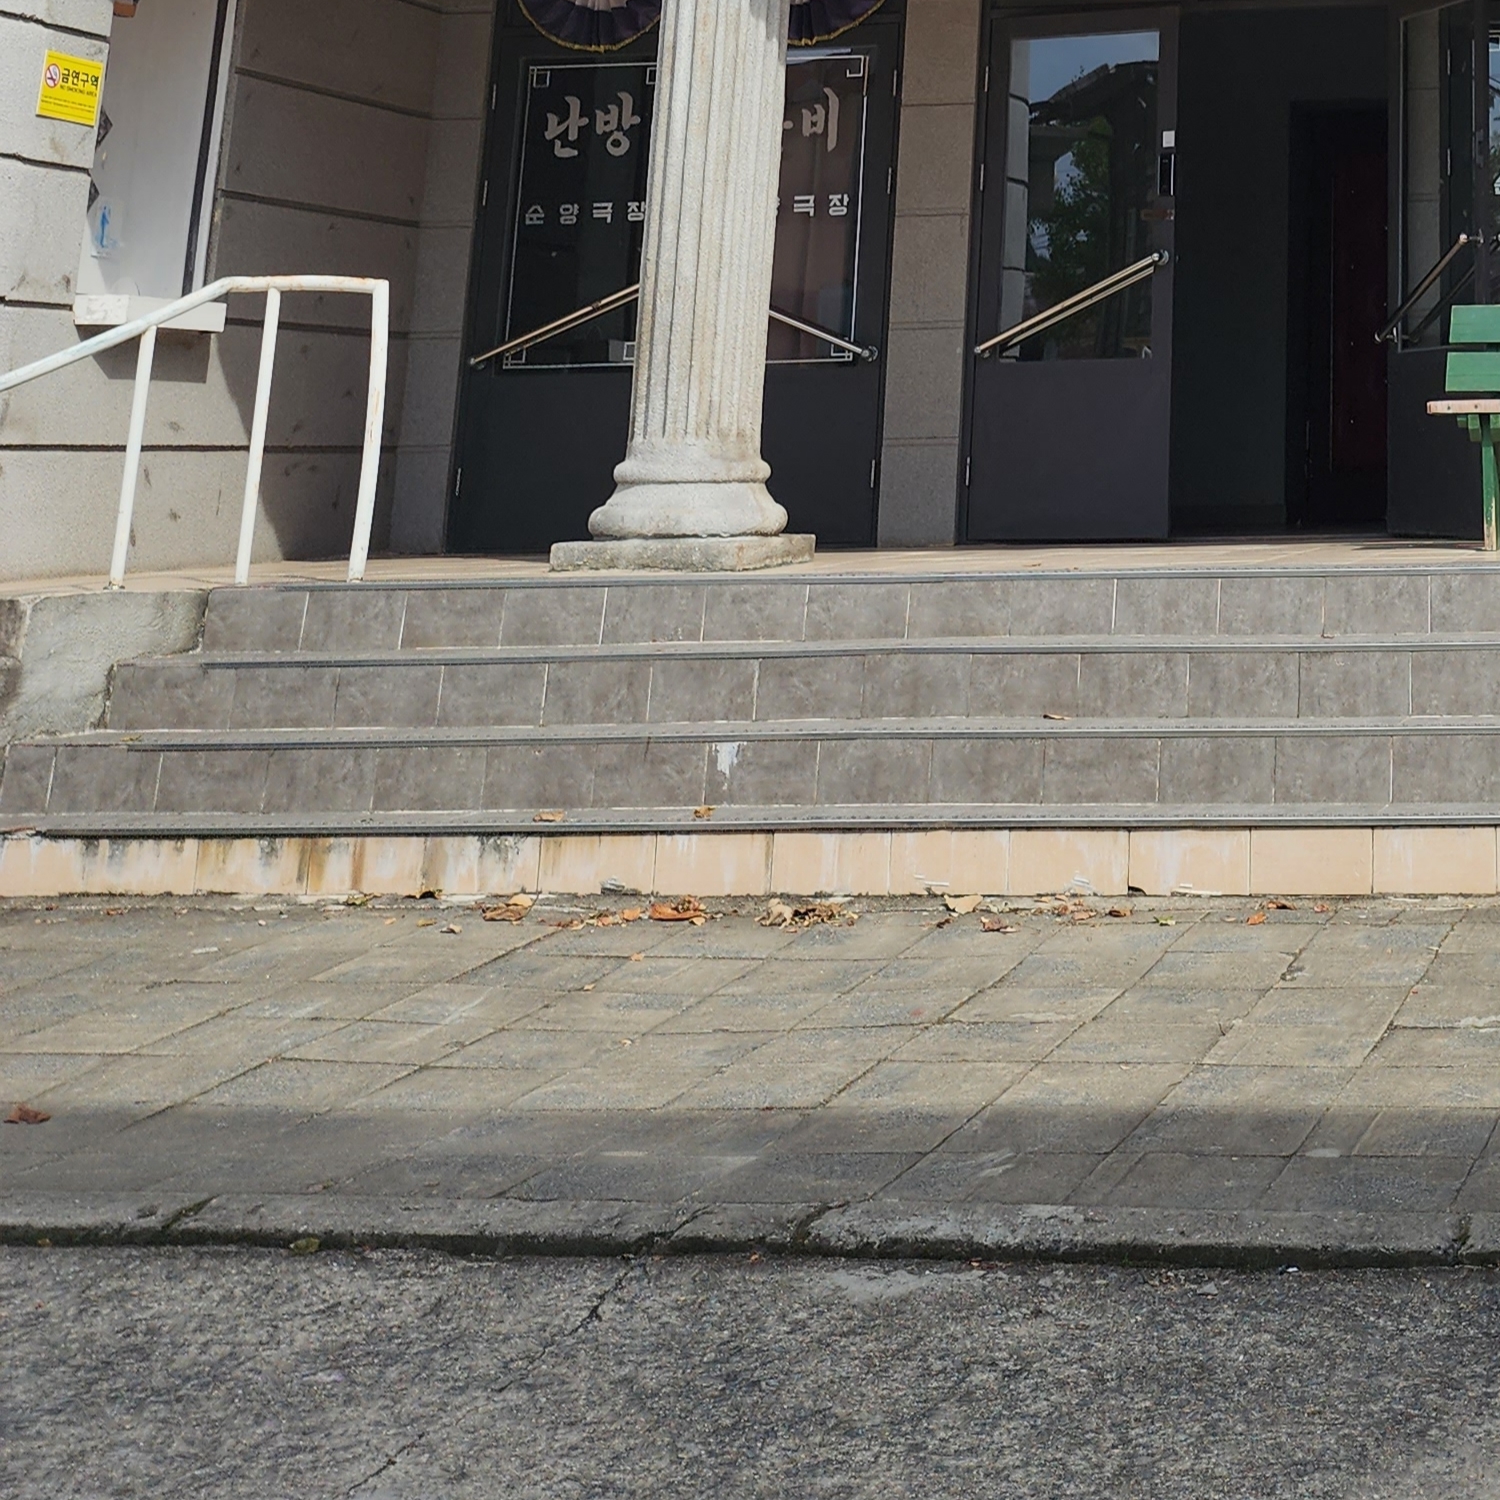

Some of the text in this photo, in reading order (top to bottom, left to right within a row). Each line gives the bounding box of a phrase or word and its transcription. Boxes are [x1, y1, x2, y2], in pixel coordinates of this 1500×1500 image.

[61, 67, 99, 91] 금연구역
[544, 91, 641, 159] 난방
[784, 87, 840, 152] 비
[776, 193, 850, 218] 극장
